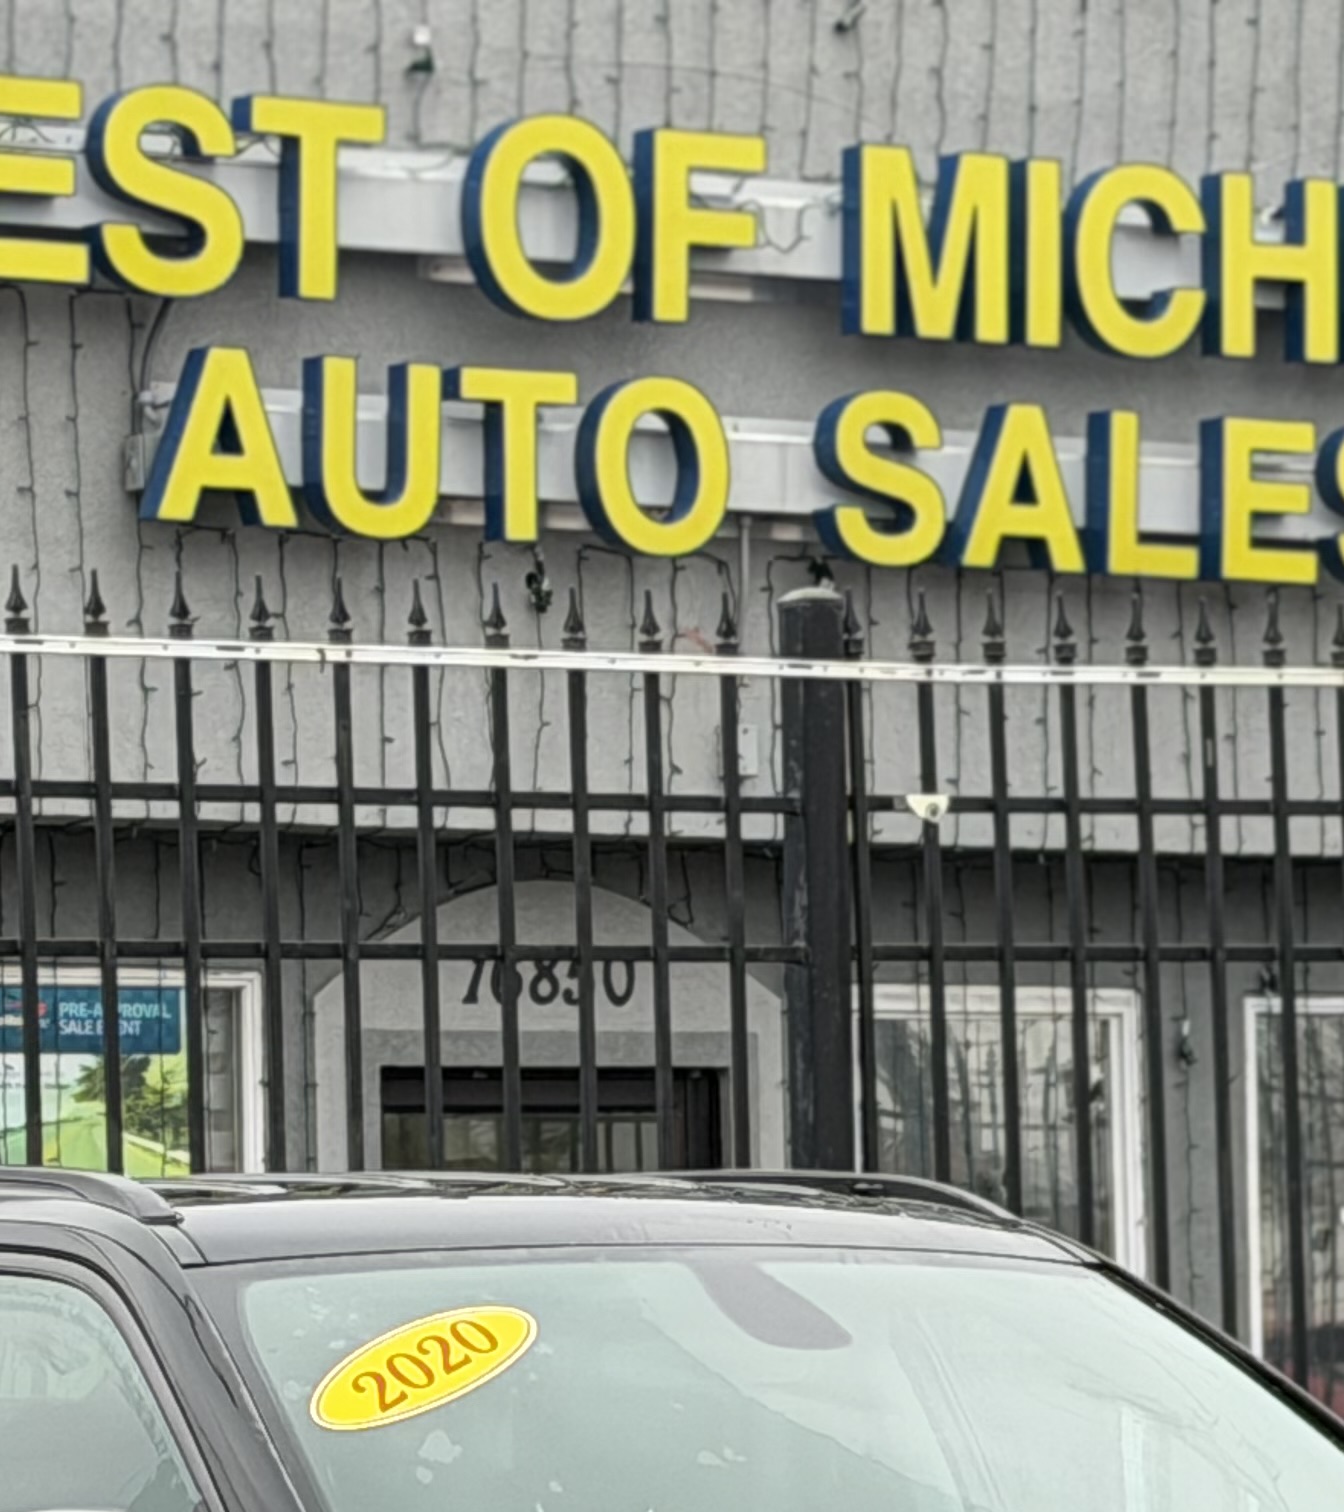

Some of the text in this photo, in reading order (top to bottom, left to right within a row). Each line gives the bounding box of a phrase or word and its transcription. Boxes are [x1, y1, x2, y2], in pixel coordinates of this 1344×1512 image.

[468, 114, 767, 323] OF
[148, 345, 730, 557] AUTO
[58, 1001, 172, 1018] PRE-APROVAL
[58, 1019, 94, 1036] SALE
[95, 1019, 142, 1037] ENT
[351, 1318, 499, 1414] 2020
